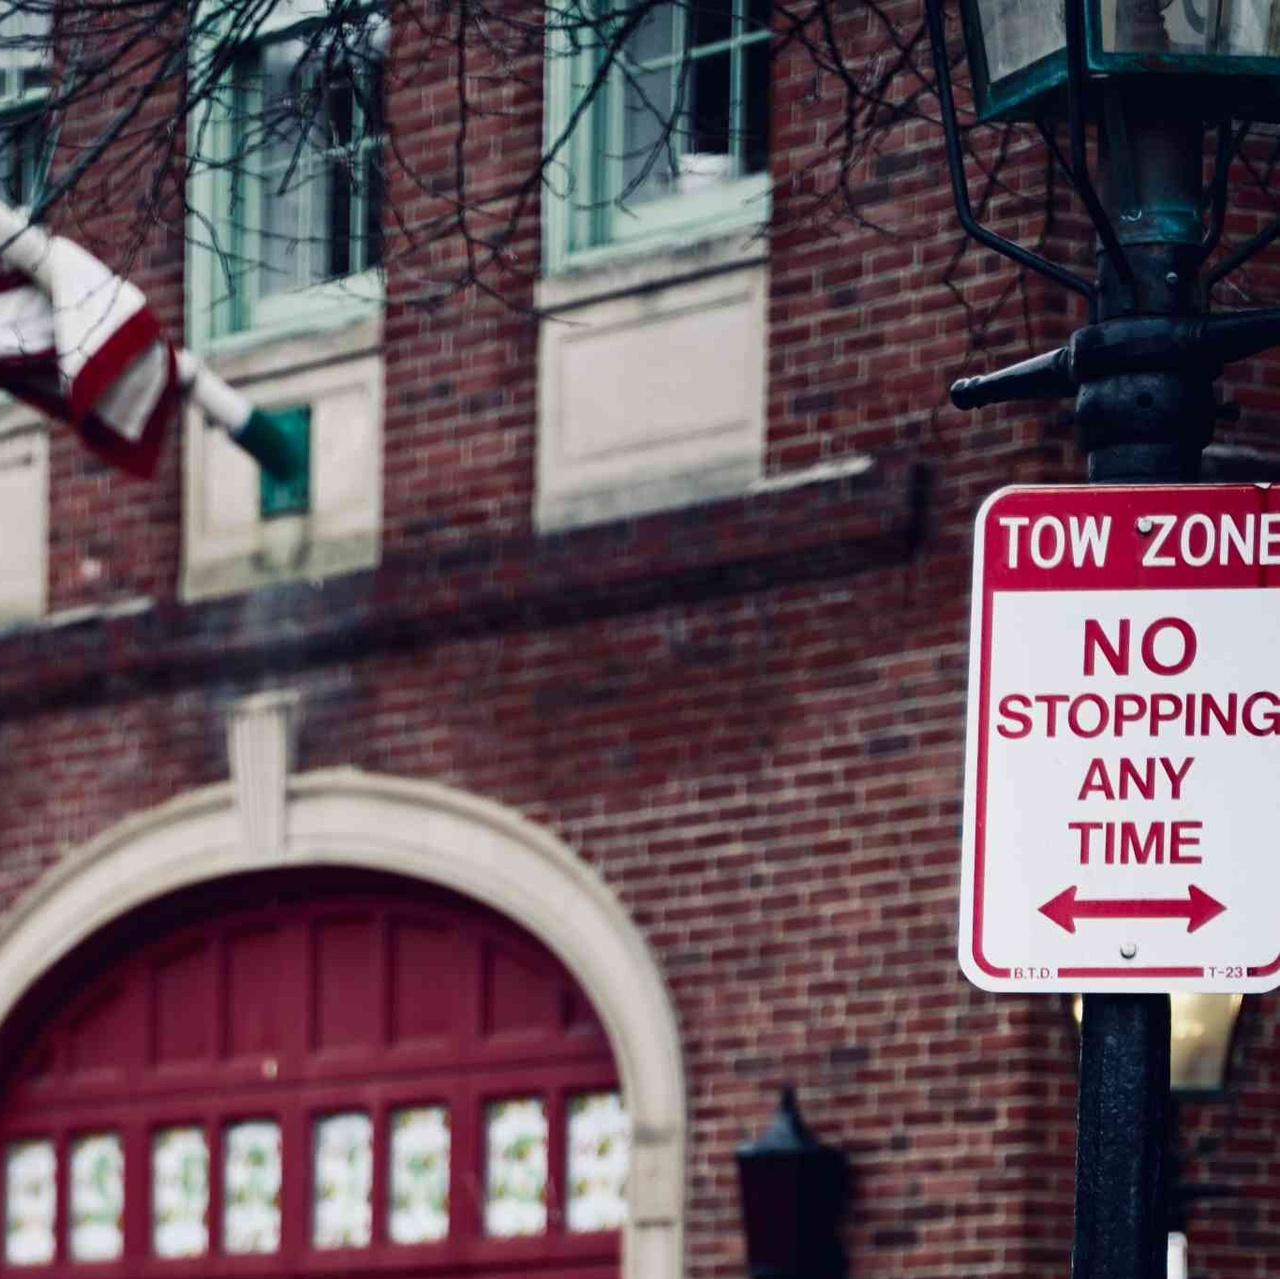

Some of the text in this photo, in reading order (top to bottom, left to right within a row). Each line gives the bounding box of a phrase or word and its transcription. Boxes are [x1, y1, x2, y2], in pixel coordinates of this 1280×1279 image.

[998, 513, 1280, 569] TOW ZONE
[1082, 617, 1198, 677] NO
[996, 691, 1280, 740] STOPPING
[1077, 756, 1195, 801] ANY
[1068, 820, 1203, 865] TIME
[1013, 966, 1243, 979] B.T.D. T-23
